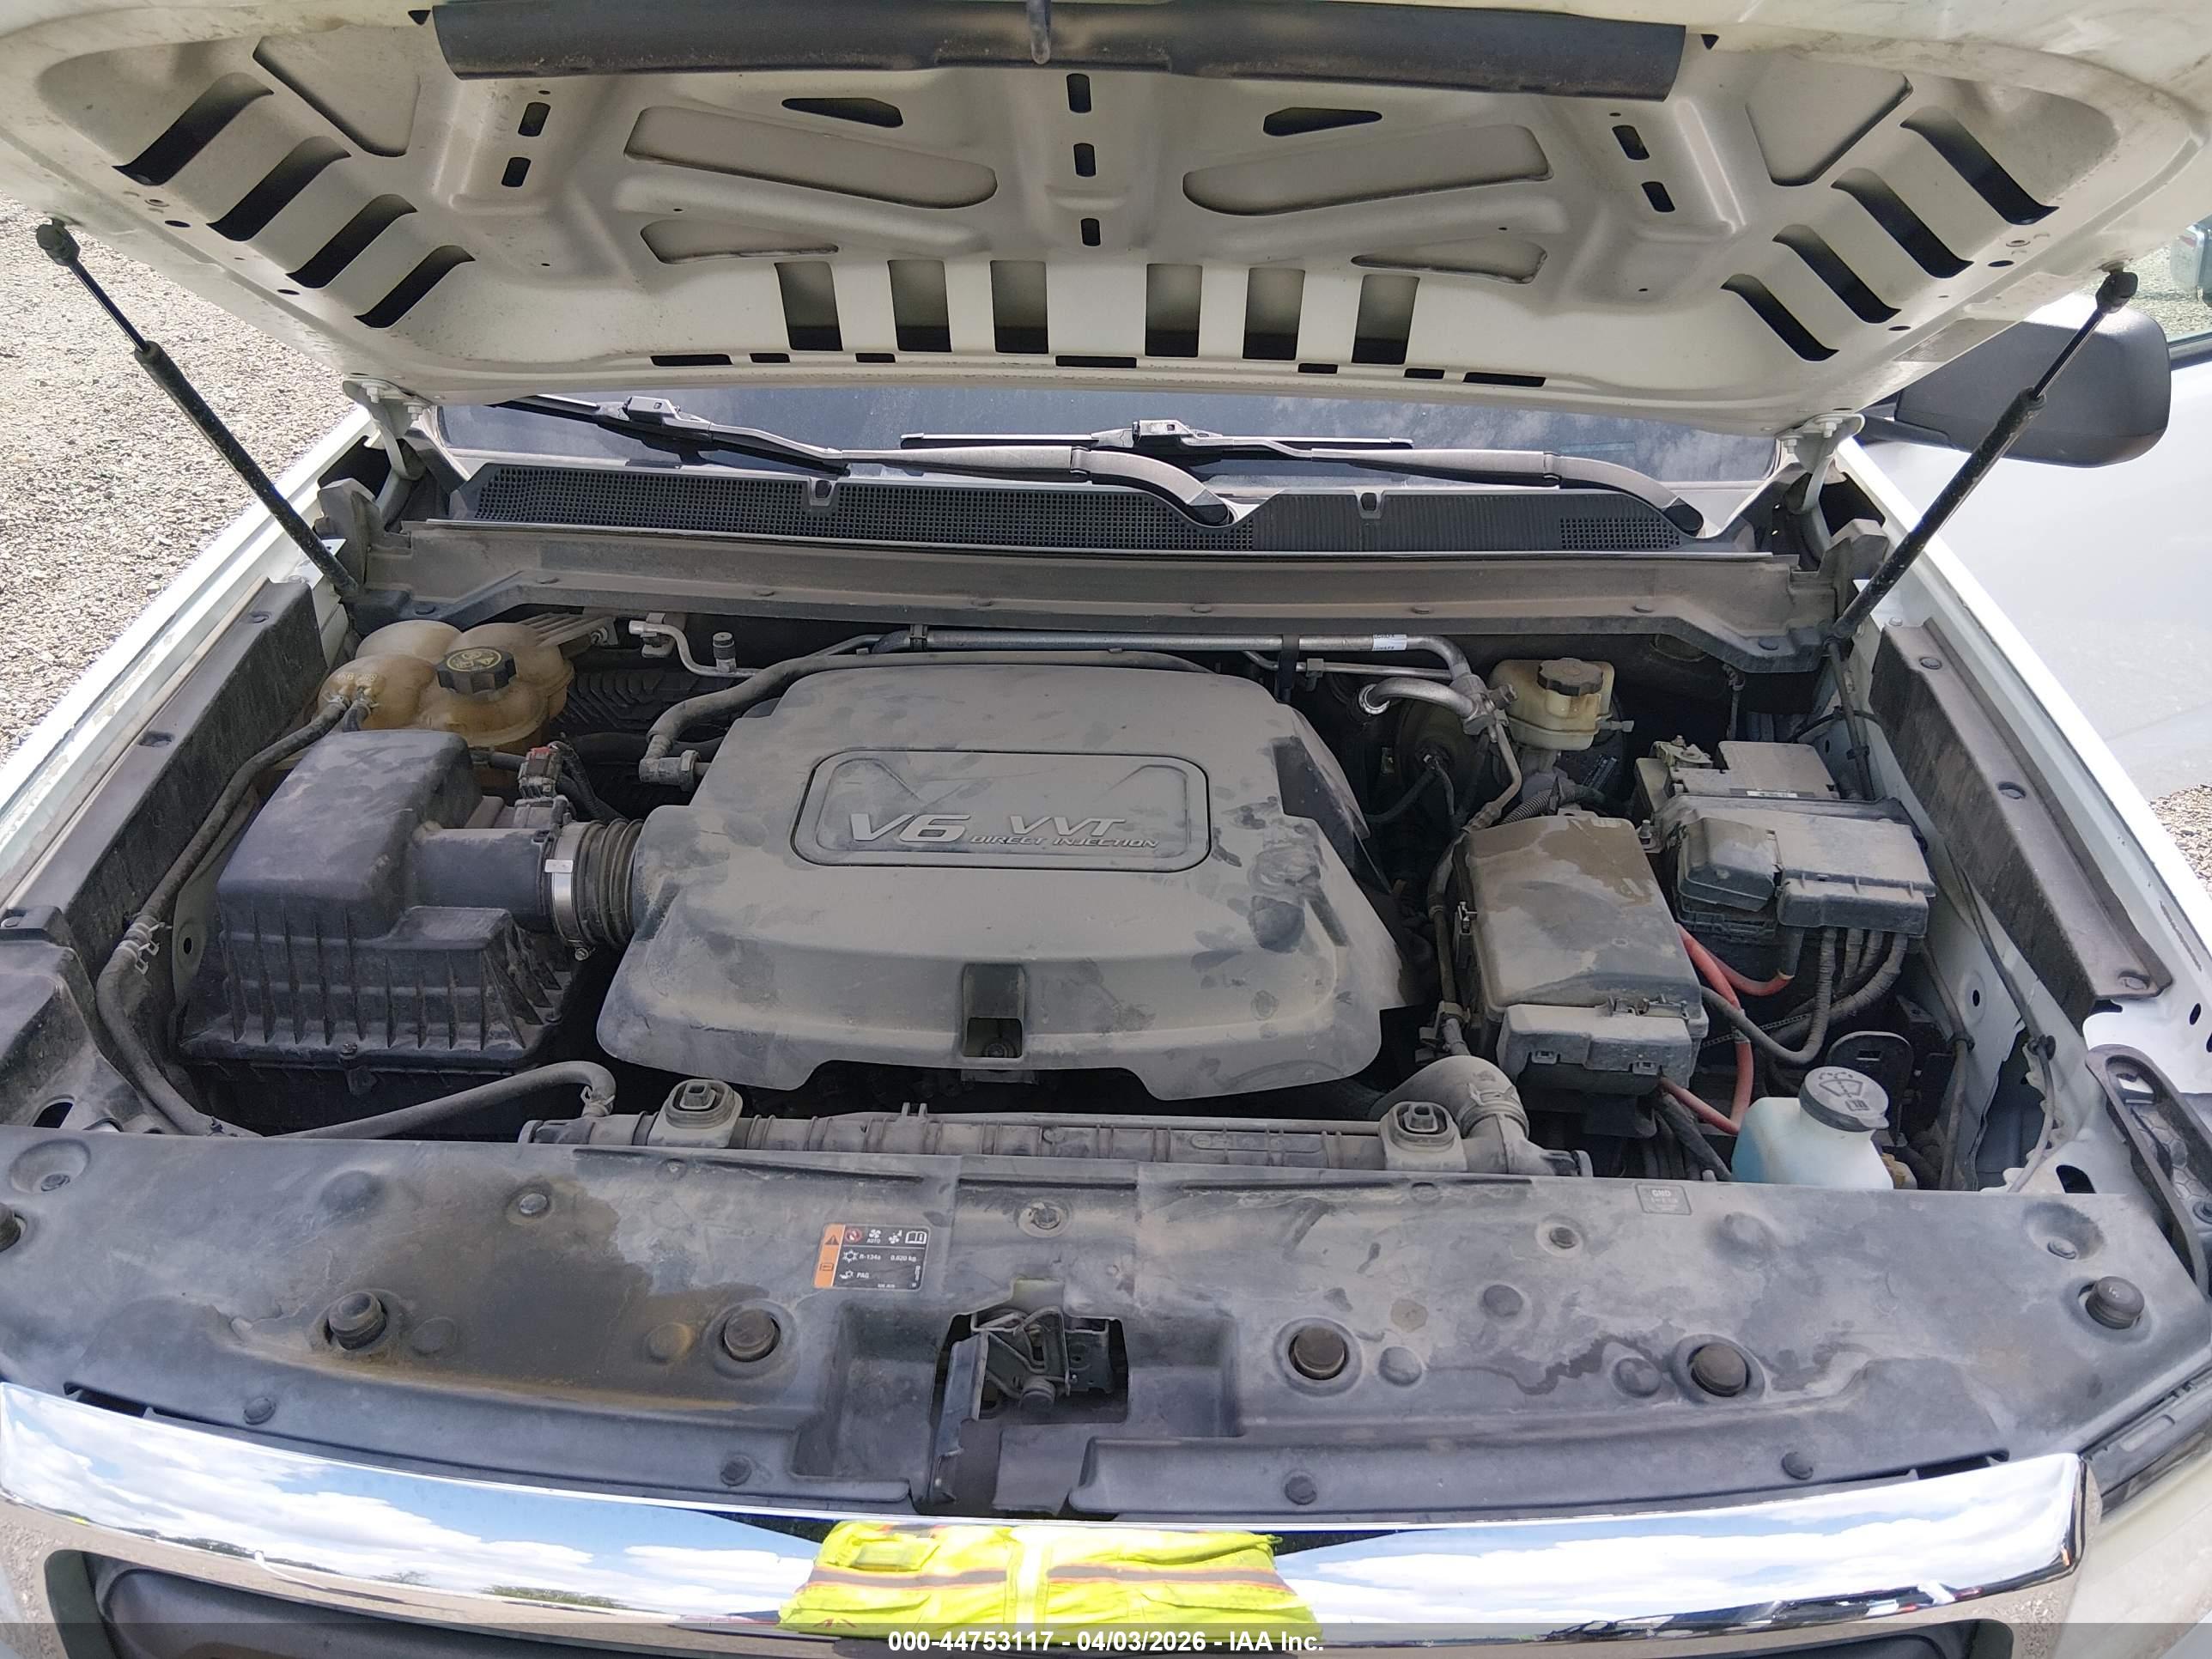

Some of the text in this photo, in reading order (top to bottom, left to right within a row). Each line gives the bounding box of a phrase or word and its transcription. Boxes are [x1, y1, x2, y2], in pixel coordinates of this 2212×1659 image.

[850, 813, 1126, 842] V6 VVT
[970, 835, 1160, 848] DIRECT INJECTION
